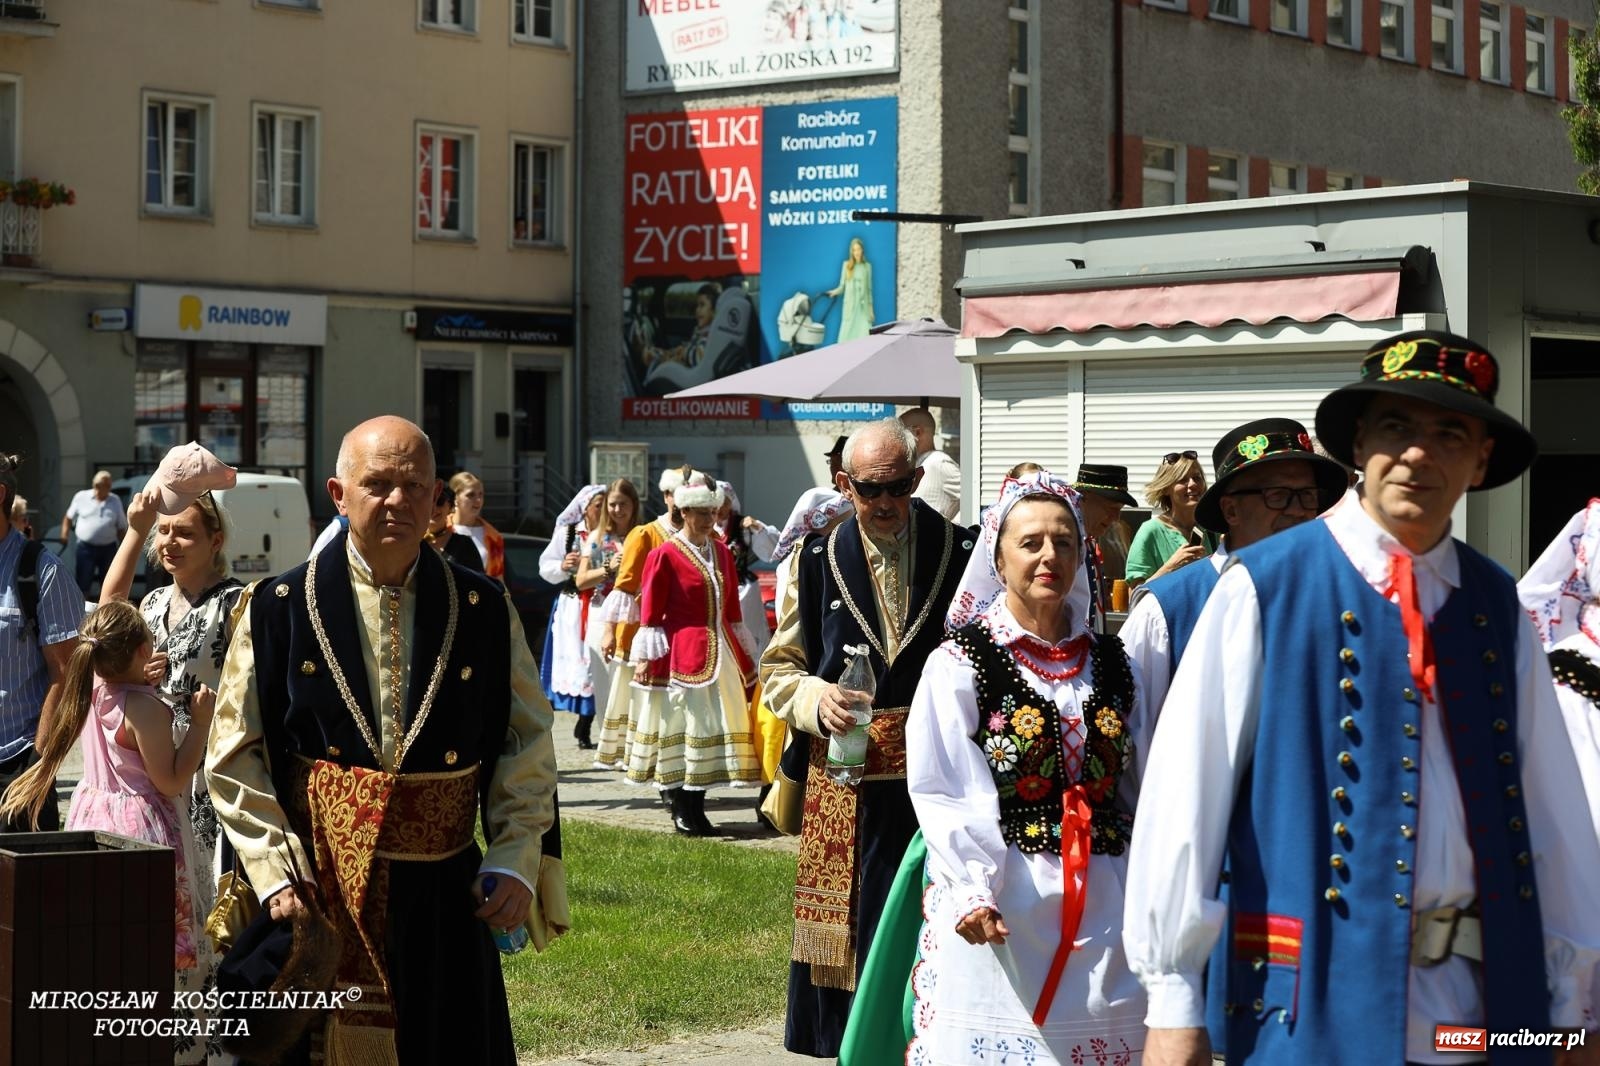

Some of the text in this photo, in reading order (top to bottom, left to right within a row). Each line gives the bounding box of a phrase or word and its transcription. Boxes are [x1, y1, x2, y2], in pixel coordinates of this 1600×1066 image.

[647, 45, 873, 83] RYBNIK, ul. ŻORSKA 192
[798, 109, 860, 128] Racibórz
[630, 115, 760, 152] FOTELIKI
[781, 130, 878, 151] Komunalna 7
[798, 164, 859, 180] FOTELIKI
[631, 167, 757, 209] RATUJĄ
[769, 185, 888, 204] SAMOCHODOWE
[768, 208, 815, 226] WÓZKI
[633, 219, 749, 263] ŻYCIE!
[208, 306, 290, 327] RAINBOW
[632, 400, 750, 416] FOTELIKOWANIE
